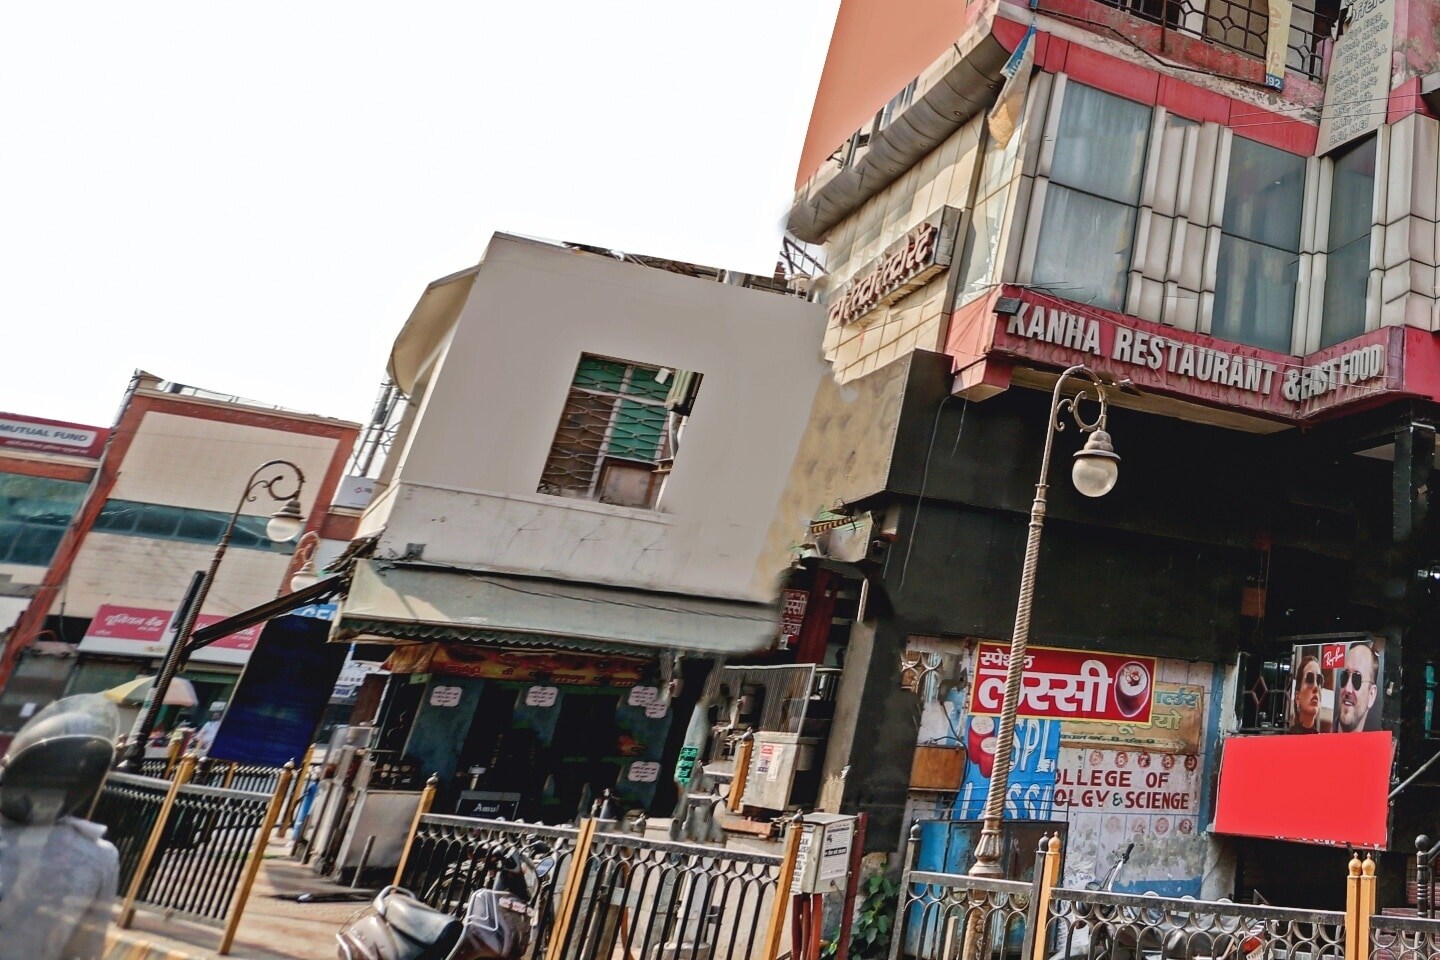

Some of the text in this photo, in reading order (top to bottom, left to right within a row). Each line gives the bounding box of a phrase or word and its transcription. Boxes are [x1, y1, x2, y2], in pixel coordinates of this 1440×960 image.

[1006, 302, 1101, 356] KANHA
[1111, 326, 1278, 396] RESTAURANT
[1284, 369, 1301, 402] &
[54, 431, 88, 442] FUND
[978, 659, 1113, 713] लस्सी
[1145, 772, 1170, 788] OF
[473, 803, 500, 813] Amul
